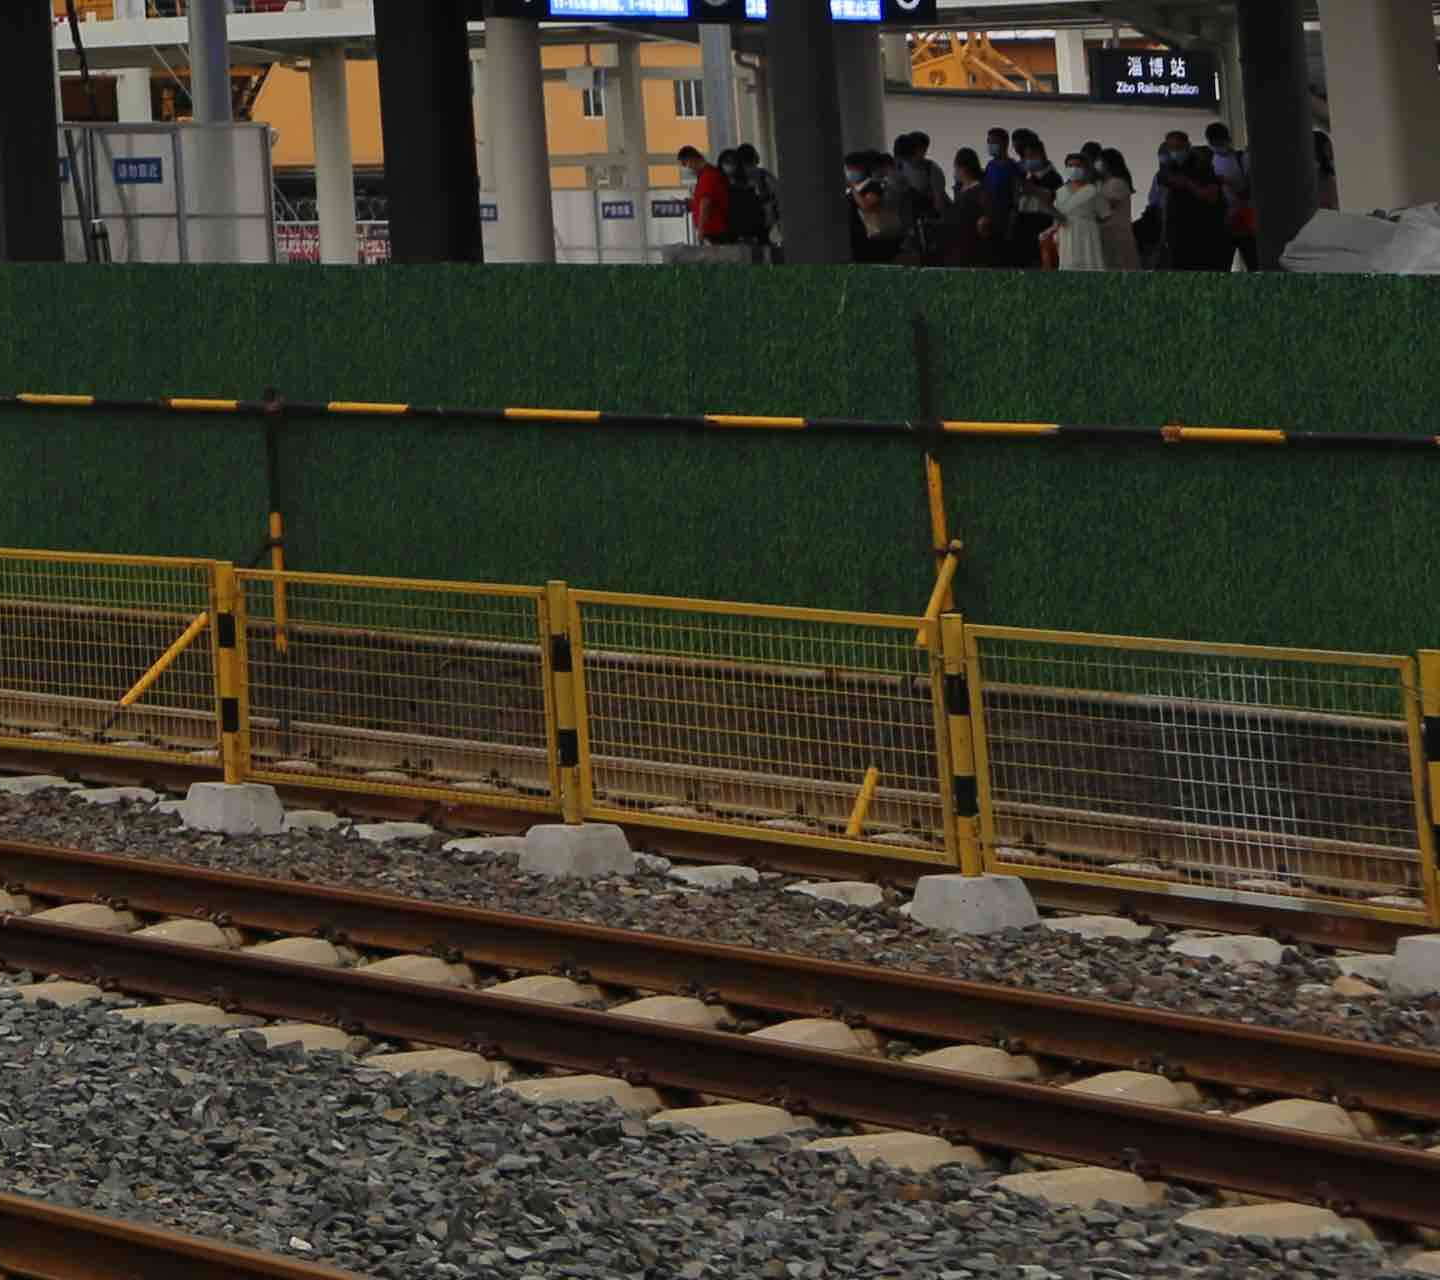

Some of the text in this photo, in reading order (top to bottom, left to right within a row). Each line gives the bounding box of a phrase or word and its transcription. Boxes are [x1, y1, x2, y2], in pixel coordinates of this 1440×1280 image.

[1127, 56, 1186, 78] 淄博站
[1116, 81, 1199, 97] Zibo Railway Station
